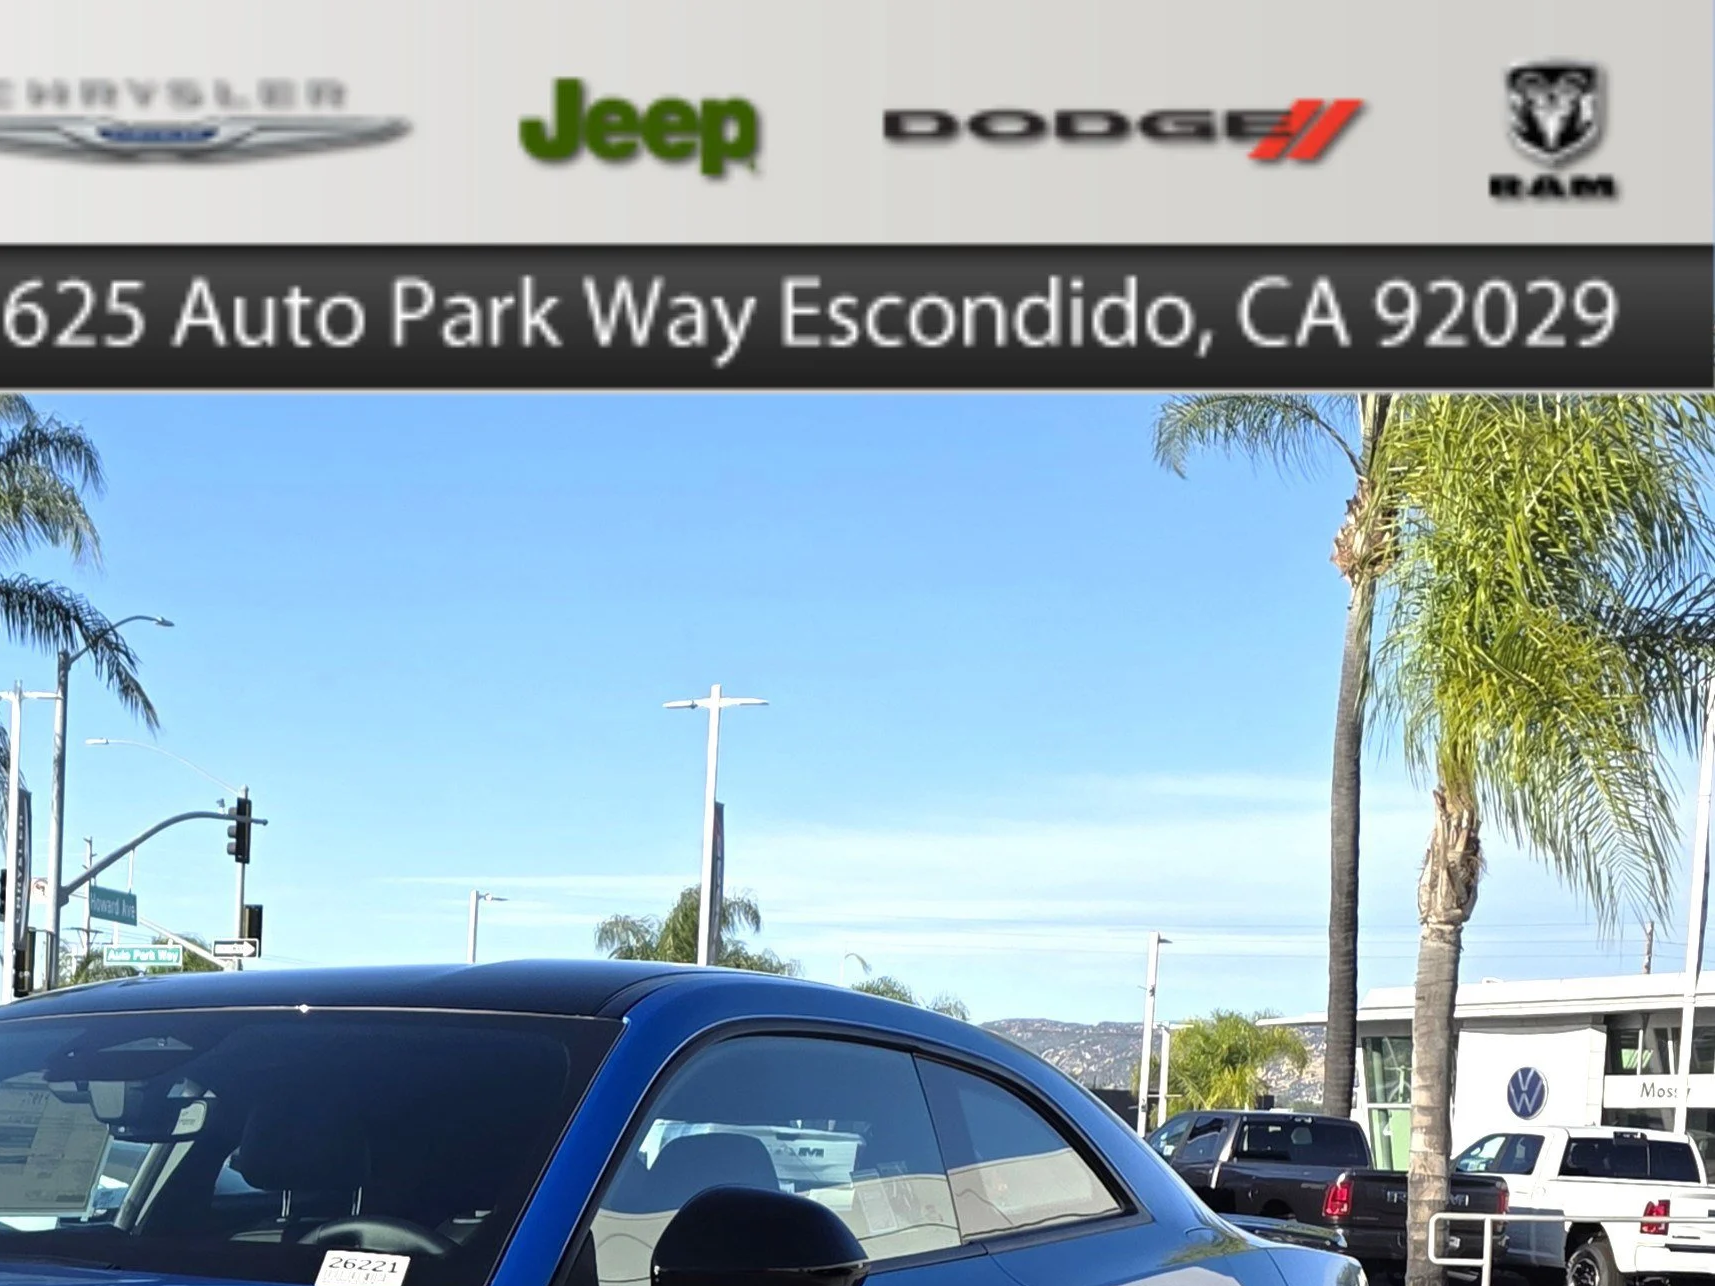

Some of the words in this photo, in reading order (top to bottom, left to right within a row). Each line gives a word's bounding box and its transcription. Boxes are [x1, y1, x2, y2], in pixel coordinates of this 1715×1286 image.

[90, 892, 120, 917] Howard
[122, 899, 135, 919] Ave
[108, 949, 131, 961] Auto
[132, 949, 156, 961] Park
[157, 949, 179, 963] Way
[328, 1256, 398, 1274] 26221
